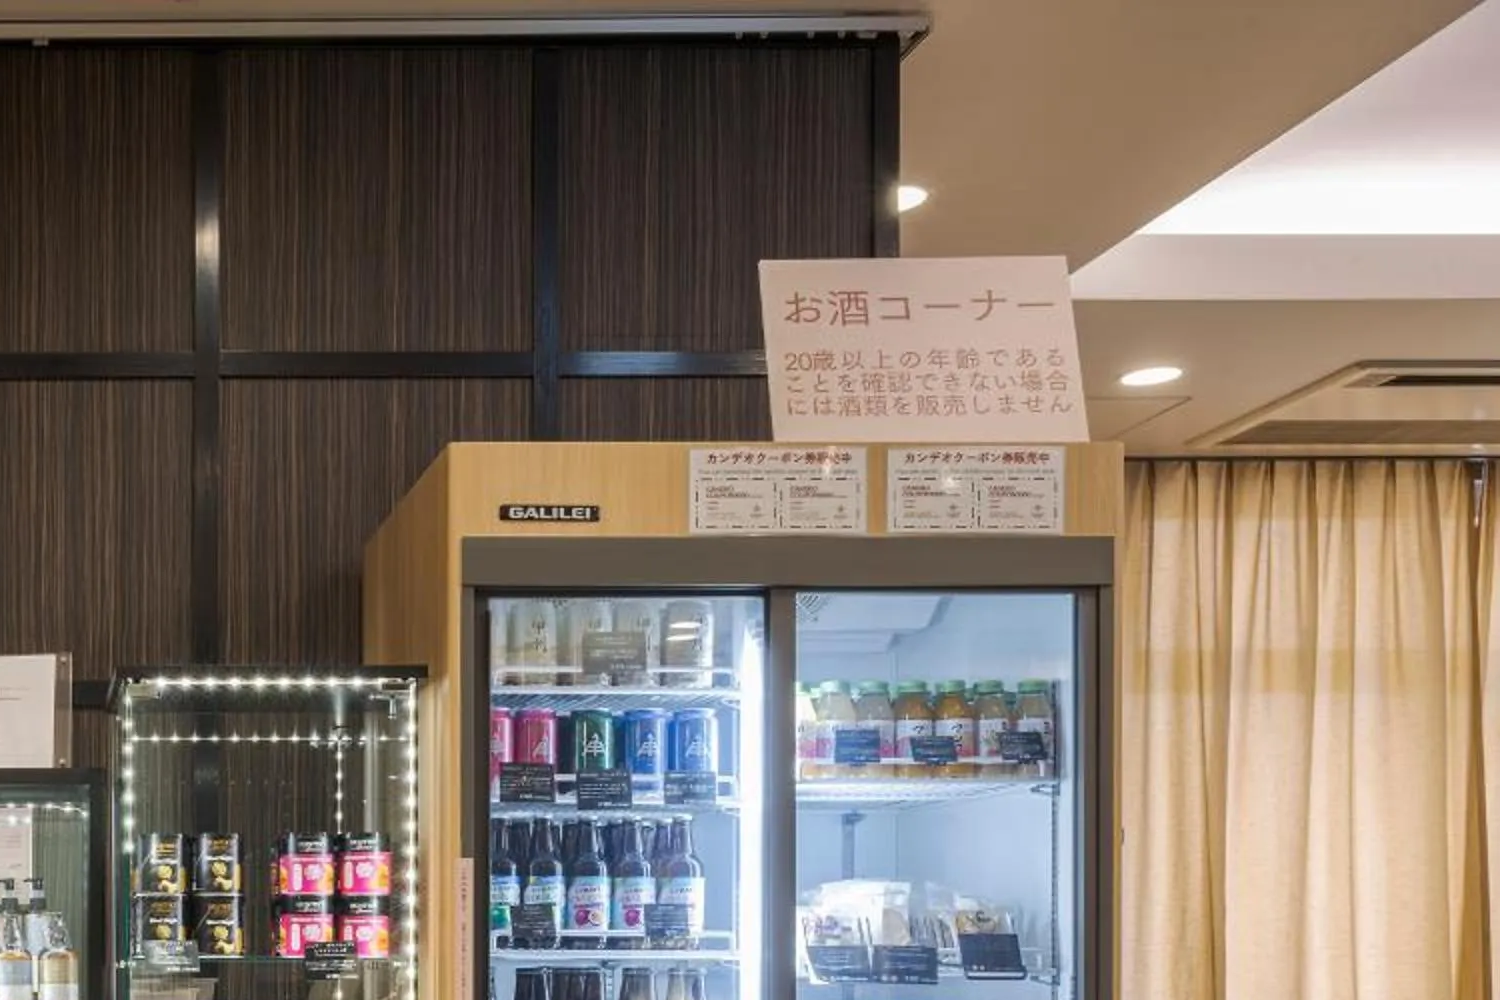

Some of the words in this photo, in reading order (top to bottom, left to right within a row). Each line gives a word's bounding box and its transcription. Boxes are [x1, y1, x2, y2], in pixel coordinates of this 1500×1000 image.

[784, 290, 1055, 327] お酒コーナー
[785, 348, 1067, 373] 20歳以上の年齢である
[786, 371, 1069, 394] ことを確認できない場合
[787, 394, 1071, 417] には酒類を販売しません
[508, 506, 592, 520] GALILEI
